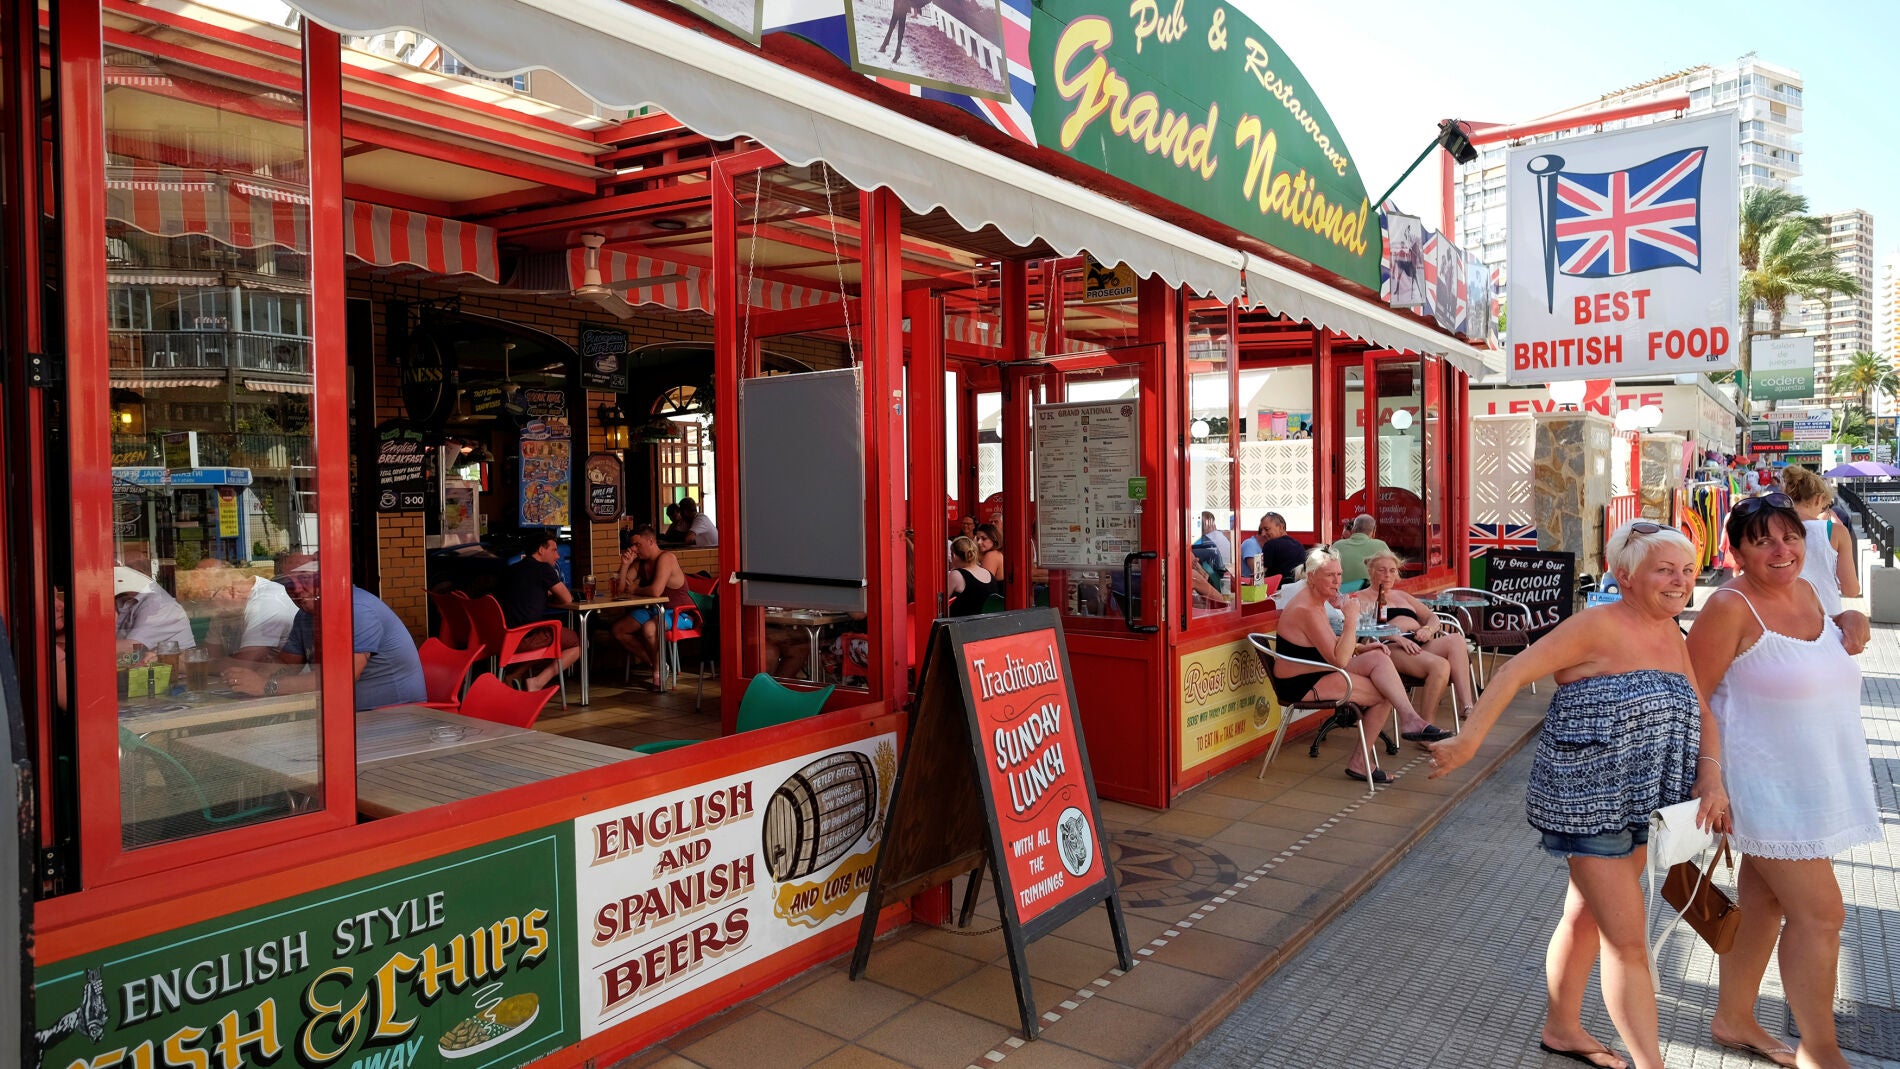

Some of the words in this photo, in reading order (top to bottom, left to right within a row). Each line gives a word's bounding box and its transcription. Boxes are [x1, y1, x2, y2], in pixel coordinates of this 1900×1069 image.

[1130, 0, 1188, 54] Pub
[1208, 8, 1227, 51] &
[1245, 37, 1347, 176] Restaurant
[1054, 15, 1218, 181] Grand
[1236, 113, 1368, 255] National
[1087, 287, 1132, 298] PROSEGUR
[1574, 289, 1651, 326] BEST
[1514, 335, 1623, 370] BRITISH
[1648, 326, 1730, 361] FOOD
[1760, 376, 1805, 387] codere
[1058, 409, 1079, 417] GRAND
[1081, 407, 1112, 415] NATIONAL
[1488, 392, 1663, 416] LEVNTE
[377, 454, 425, 465] BREAKFAST
[1492, 557, 1506, 569] Try
[1509, 558, 1529, 568] One
[1532, 560, 1543, 569] of
[1546, 560, 1565, 571] Our
[1491, 588, 1561, 607] SPECIALITY
[1492, 574, 1561, 592] DELICIOUS
[1491, 606, 1560, 631] GRILLS
[973, 644, 1058, 700] Traditional
[1186, 665, 1226, 703] Roast
[994, 702, 1061, 770] SUNDAY
[1197, 736, 1203, 752] TO
[1205, 732, 1213, 749] EAT
[1223, 724, 1233, 740] TAKE
[1235, 719, 1246, 735] AWAY
[812, 770, 835, 788] TETLEY
[836, 766, 857, 779] BITTER
[821, 784, 852, 801] GUINNESS
[1008, 743, 1065, 813] LUNCH
[826, 800, 835, 810] ON
[836, 790, 862, 806] DRAUGHT
[831, 811, 850, 828] ENGLISH
[850, 803, 865, 817] CIDER
[594, 781, 754, 863] ENGLISH
[824, 825, 856, 848] HEINEKEN
[656, 838, 712, 874] AND
[1013, 834, 1034, 857] WITH
[1037, 827, 1051, 848] ALL
[1029, 855, 1044, 875] THE
[594, 854, 755, 943] SPANISH
[790, 884, 819, 914] AND
[824, 873, 851, 900] LOTS
[1020, 871, 1064, 908] TRIMMINGS
[123, 931, 309, 1024] ENGLISH
[335, 891, 446, 957] STYLE
[601, 908, 749, 1008] BEERS
[304, 966, 367, 1064] &
[373, 909, 549, 1036] CHIPS
